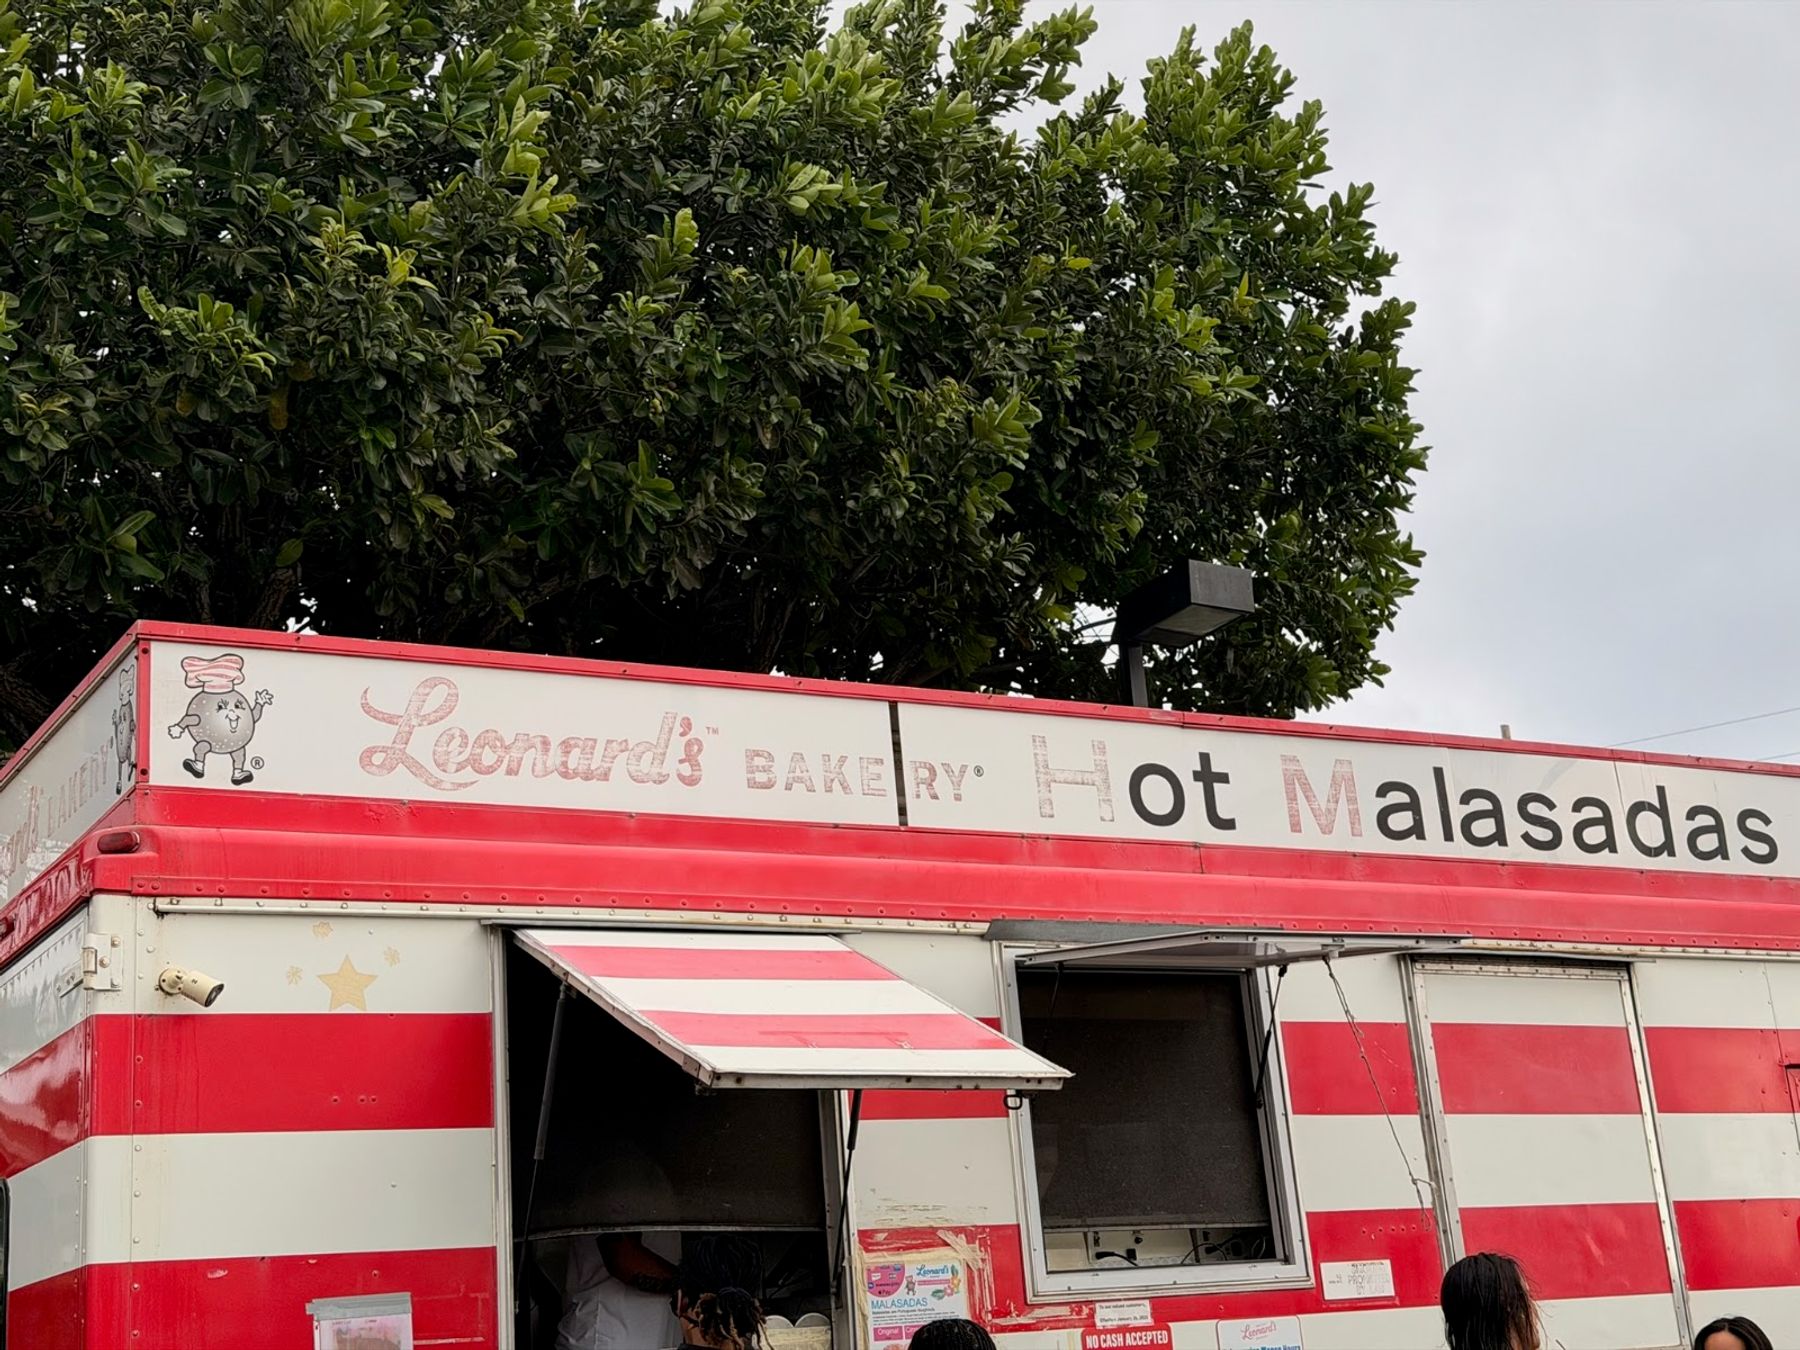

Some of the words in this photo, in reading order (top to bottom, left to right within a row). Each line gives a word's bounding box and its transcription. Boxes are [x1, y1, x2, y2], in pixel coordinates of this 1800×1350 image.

[1031, 733, 1237, 831] Hot
[1279, 753, 1780, 865] Malasadas
[916, 1264, 949, 1277] Leonard's
[871, 1297, 928, 1310] MALASADAS
[878, 1327, 899, 1335] Original
[1086, 1335, 1098, 1349] NO
[1100, 1333, 1123, 1348] CASH
[1125, 1330, 1168, 1347] ACCEPTED
